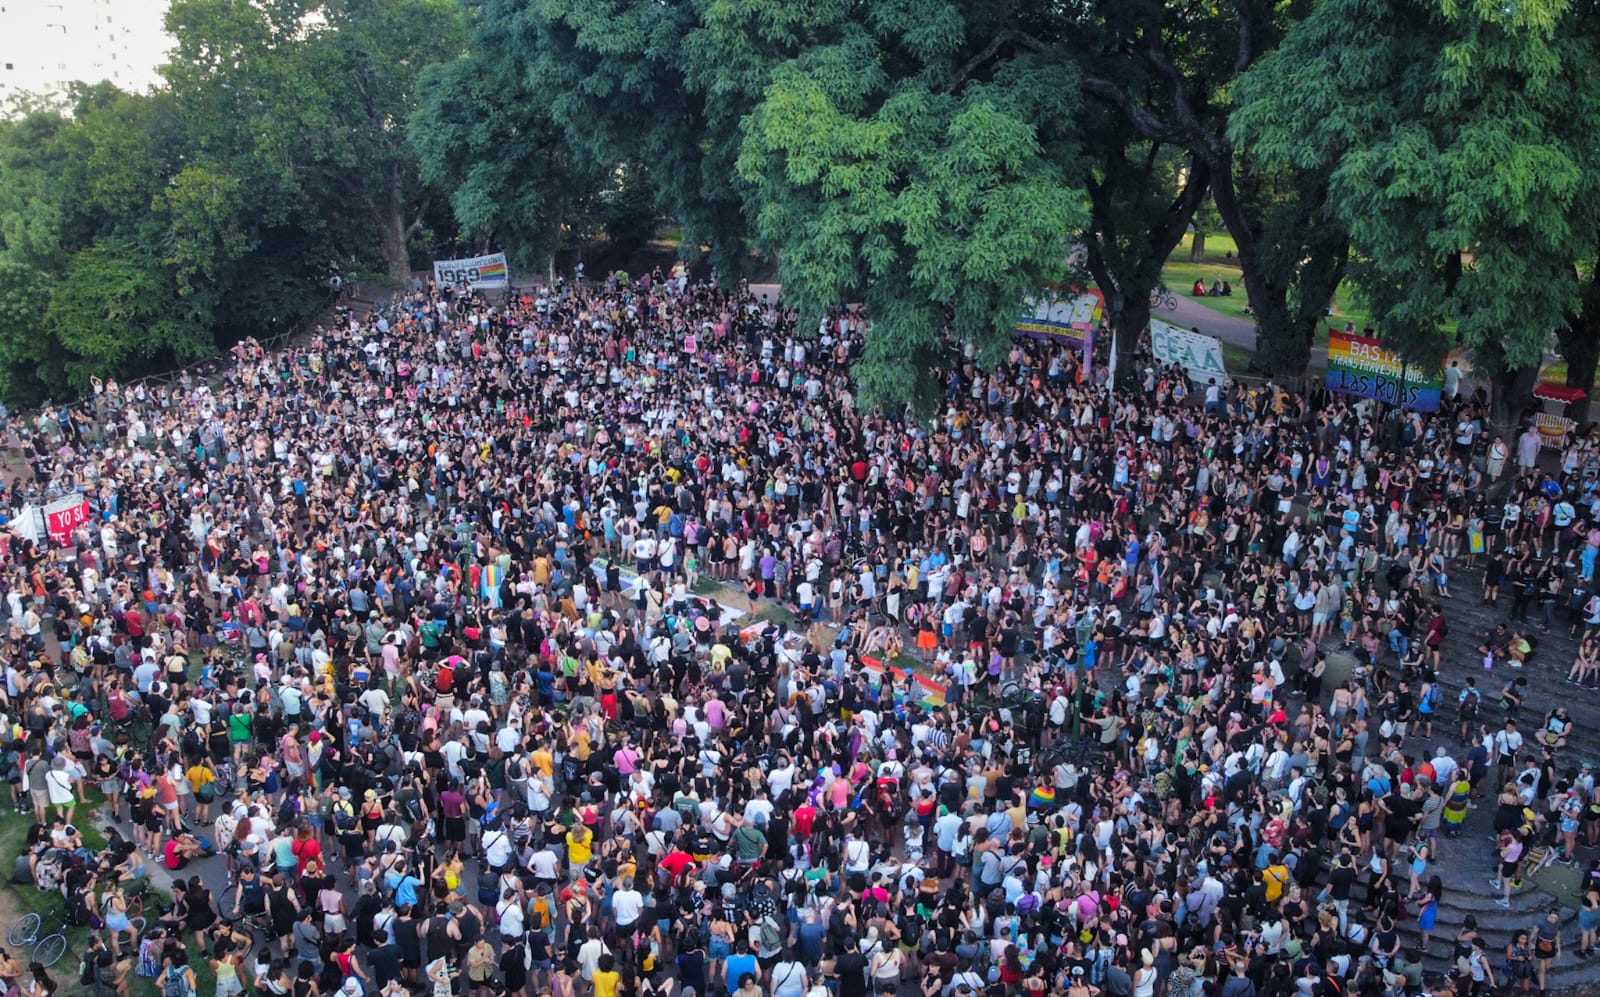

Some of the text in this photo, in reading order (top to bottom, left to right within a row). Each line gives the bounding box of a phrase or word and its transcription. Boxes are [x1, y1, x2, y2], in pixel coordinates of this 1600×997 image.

[438, 267, 480, 283] 1969
[57, 511, 71, 528] YO
[52, 532, 67, 547] TE
